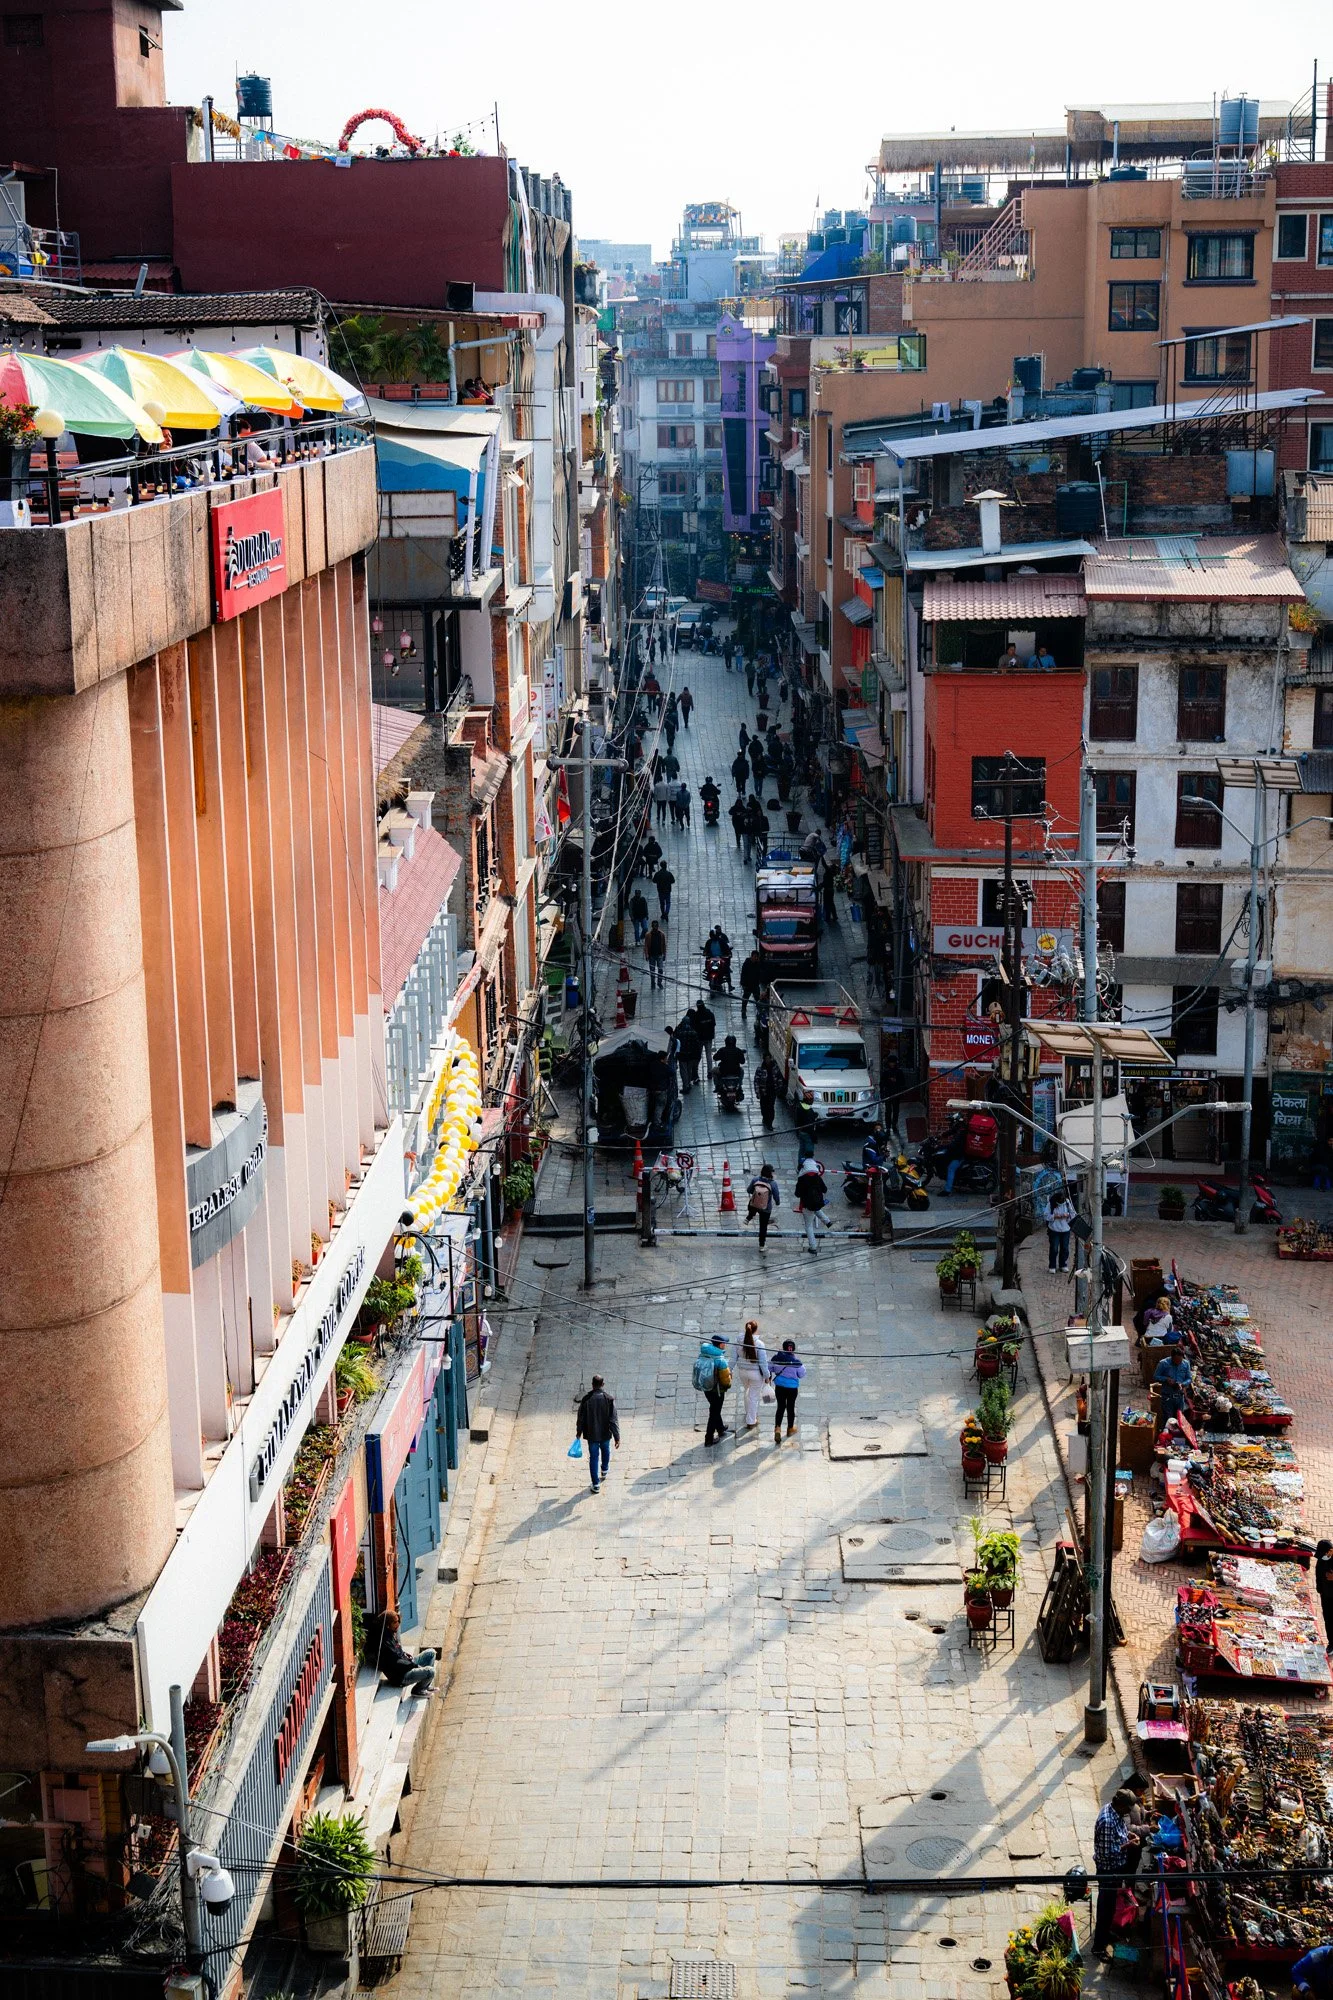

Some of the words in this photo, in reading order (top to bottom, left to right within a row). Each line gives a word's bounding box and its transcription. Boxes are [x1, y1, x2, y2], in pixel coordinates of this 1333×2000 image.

[234, 530, 272, 574] DURBAR
[966, 1034, 995, 1045] MONEY
[190, 1171, 242, 1232] EPALESE
[257, 1348, 316, 1486] HIMALAYAN
[316, 1303, 338, 1360] JAVA
[275, 1622, 325, 1786] ROADHOUSE
